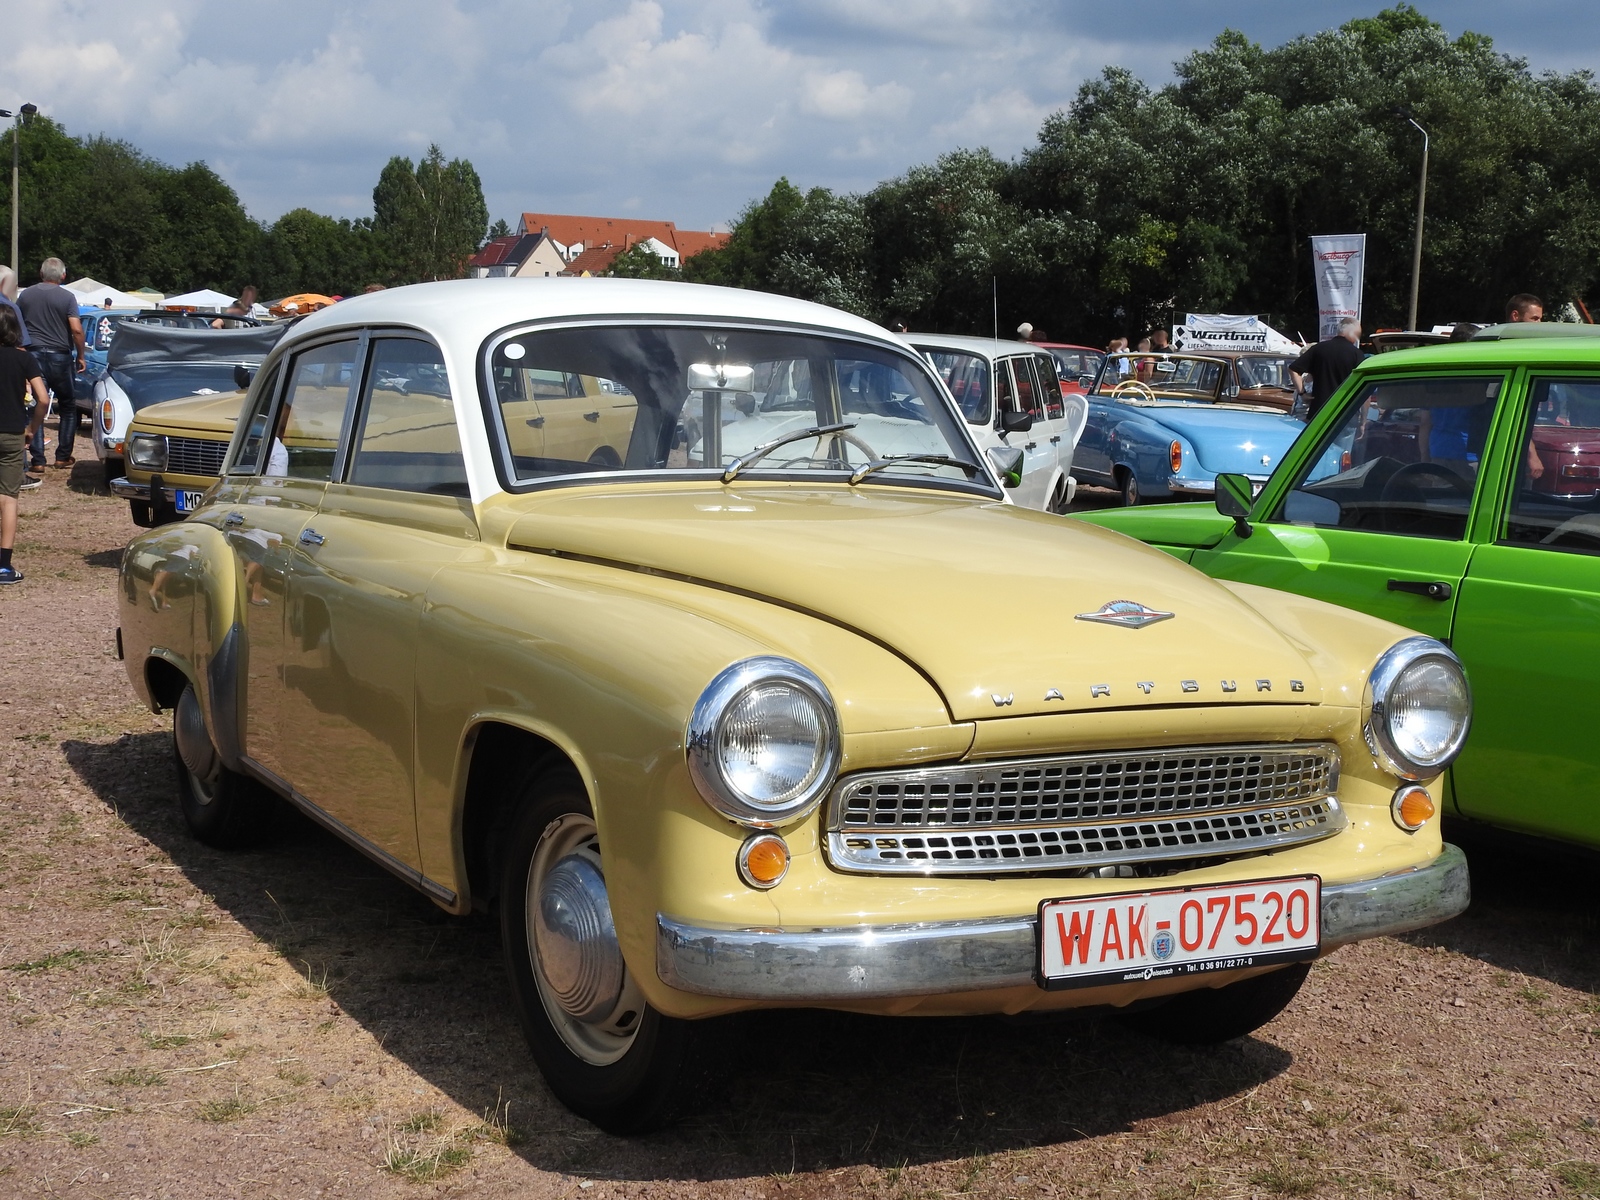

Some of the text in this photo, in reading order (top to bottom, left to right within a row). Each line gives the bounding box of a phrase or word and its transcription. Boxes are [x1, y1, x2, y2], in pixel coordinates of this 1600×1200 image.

[1187, 330, 1267, 344] Wartburg
[991, 679, 1305, 707] WARTBURG
[1056, 889, 1309, 966] WAK-07520
[1186, 964, 1198, 972] Tel.
[1215, 959, 1235, 969] 91/22
